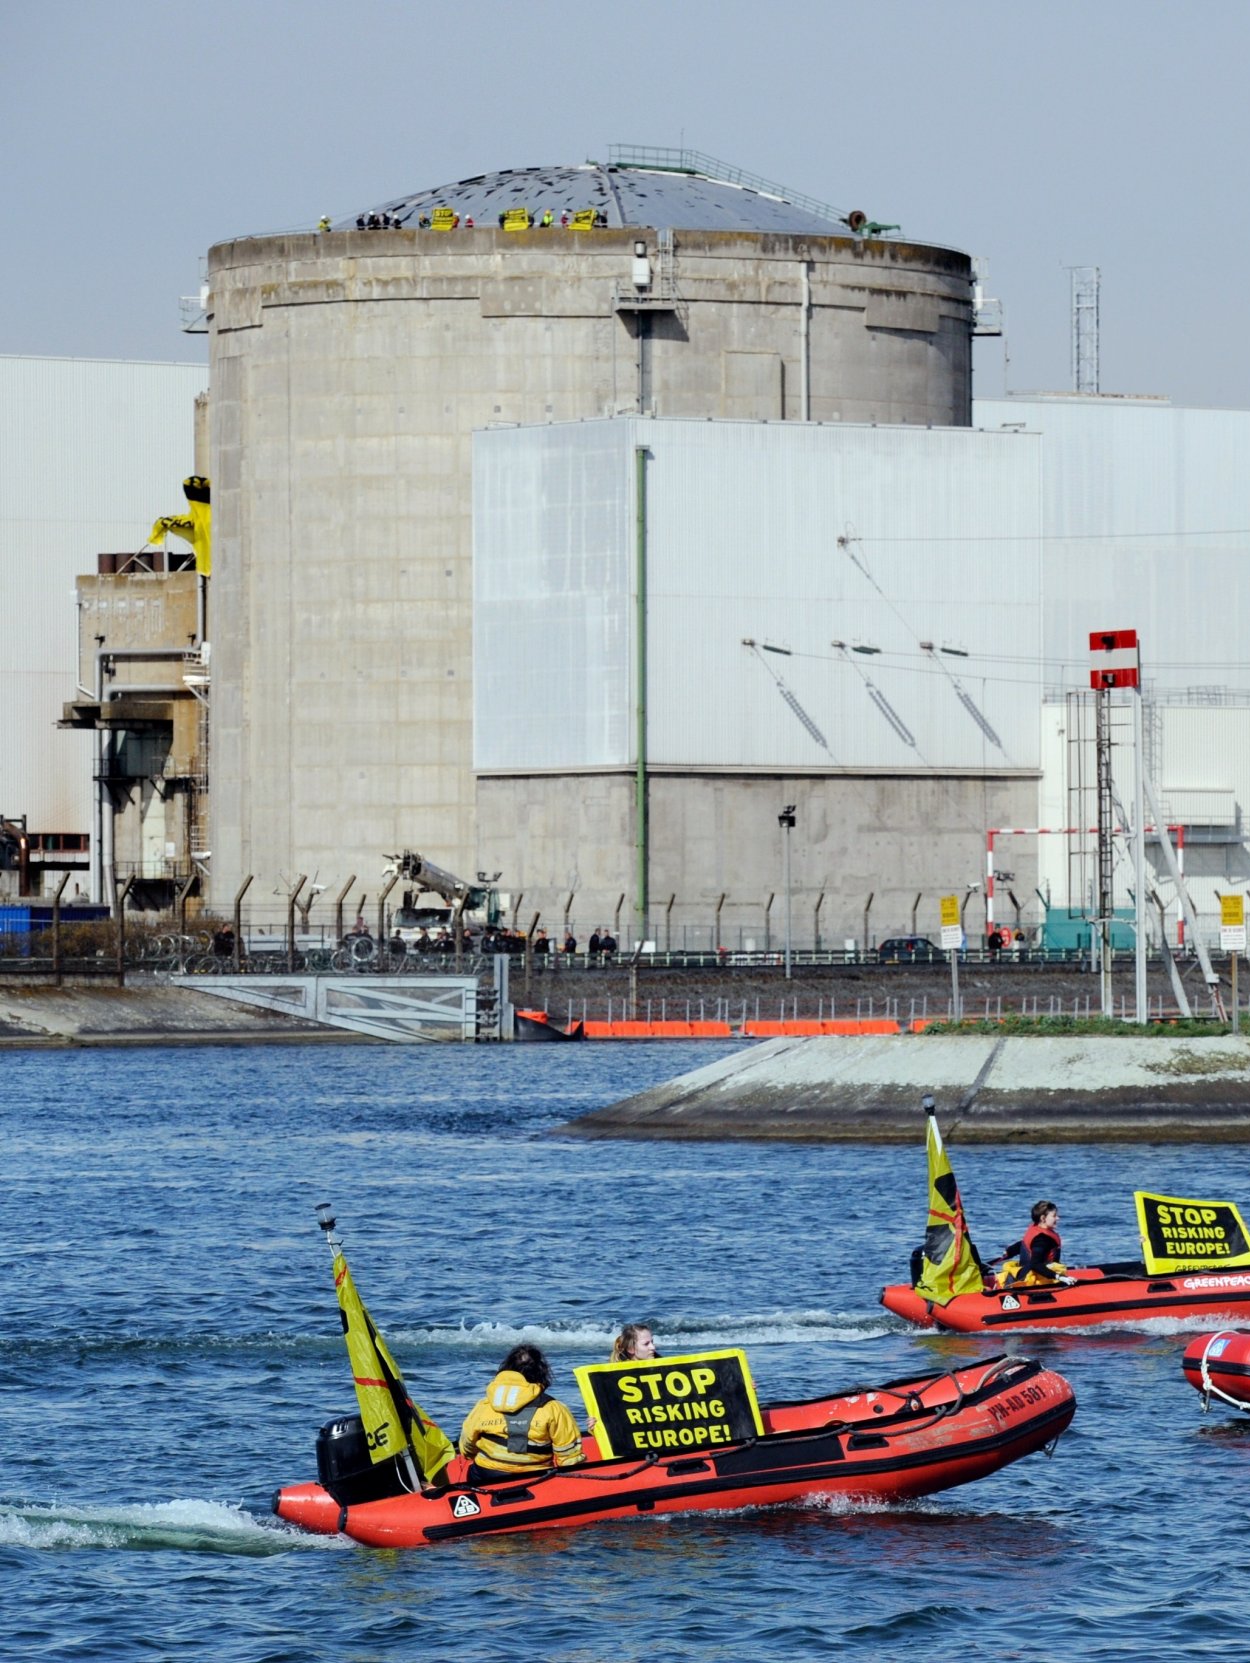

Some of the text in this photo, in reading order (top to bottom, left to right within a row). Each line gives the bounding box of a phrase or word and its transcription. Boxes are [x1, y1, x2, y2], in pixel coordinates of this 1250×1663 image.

[1156, 1204, 1218, 1225] STOP
[1161, 1226, 1226, 1240] RISKING
[1165, 1241, 1231, 1255] EUROPE!
[1174, 1263, 1231, 1273] GREENPE
[617, 1367, 716, 1403] STOP
[625, 1399, 726, 1424] RISKING
[632, 1424, 732, 1449] EUROPE!
